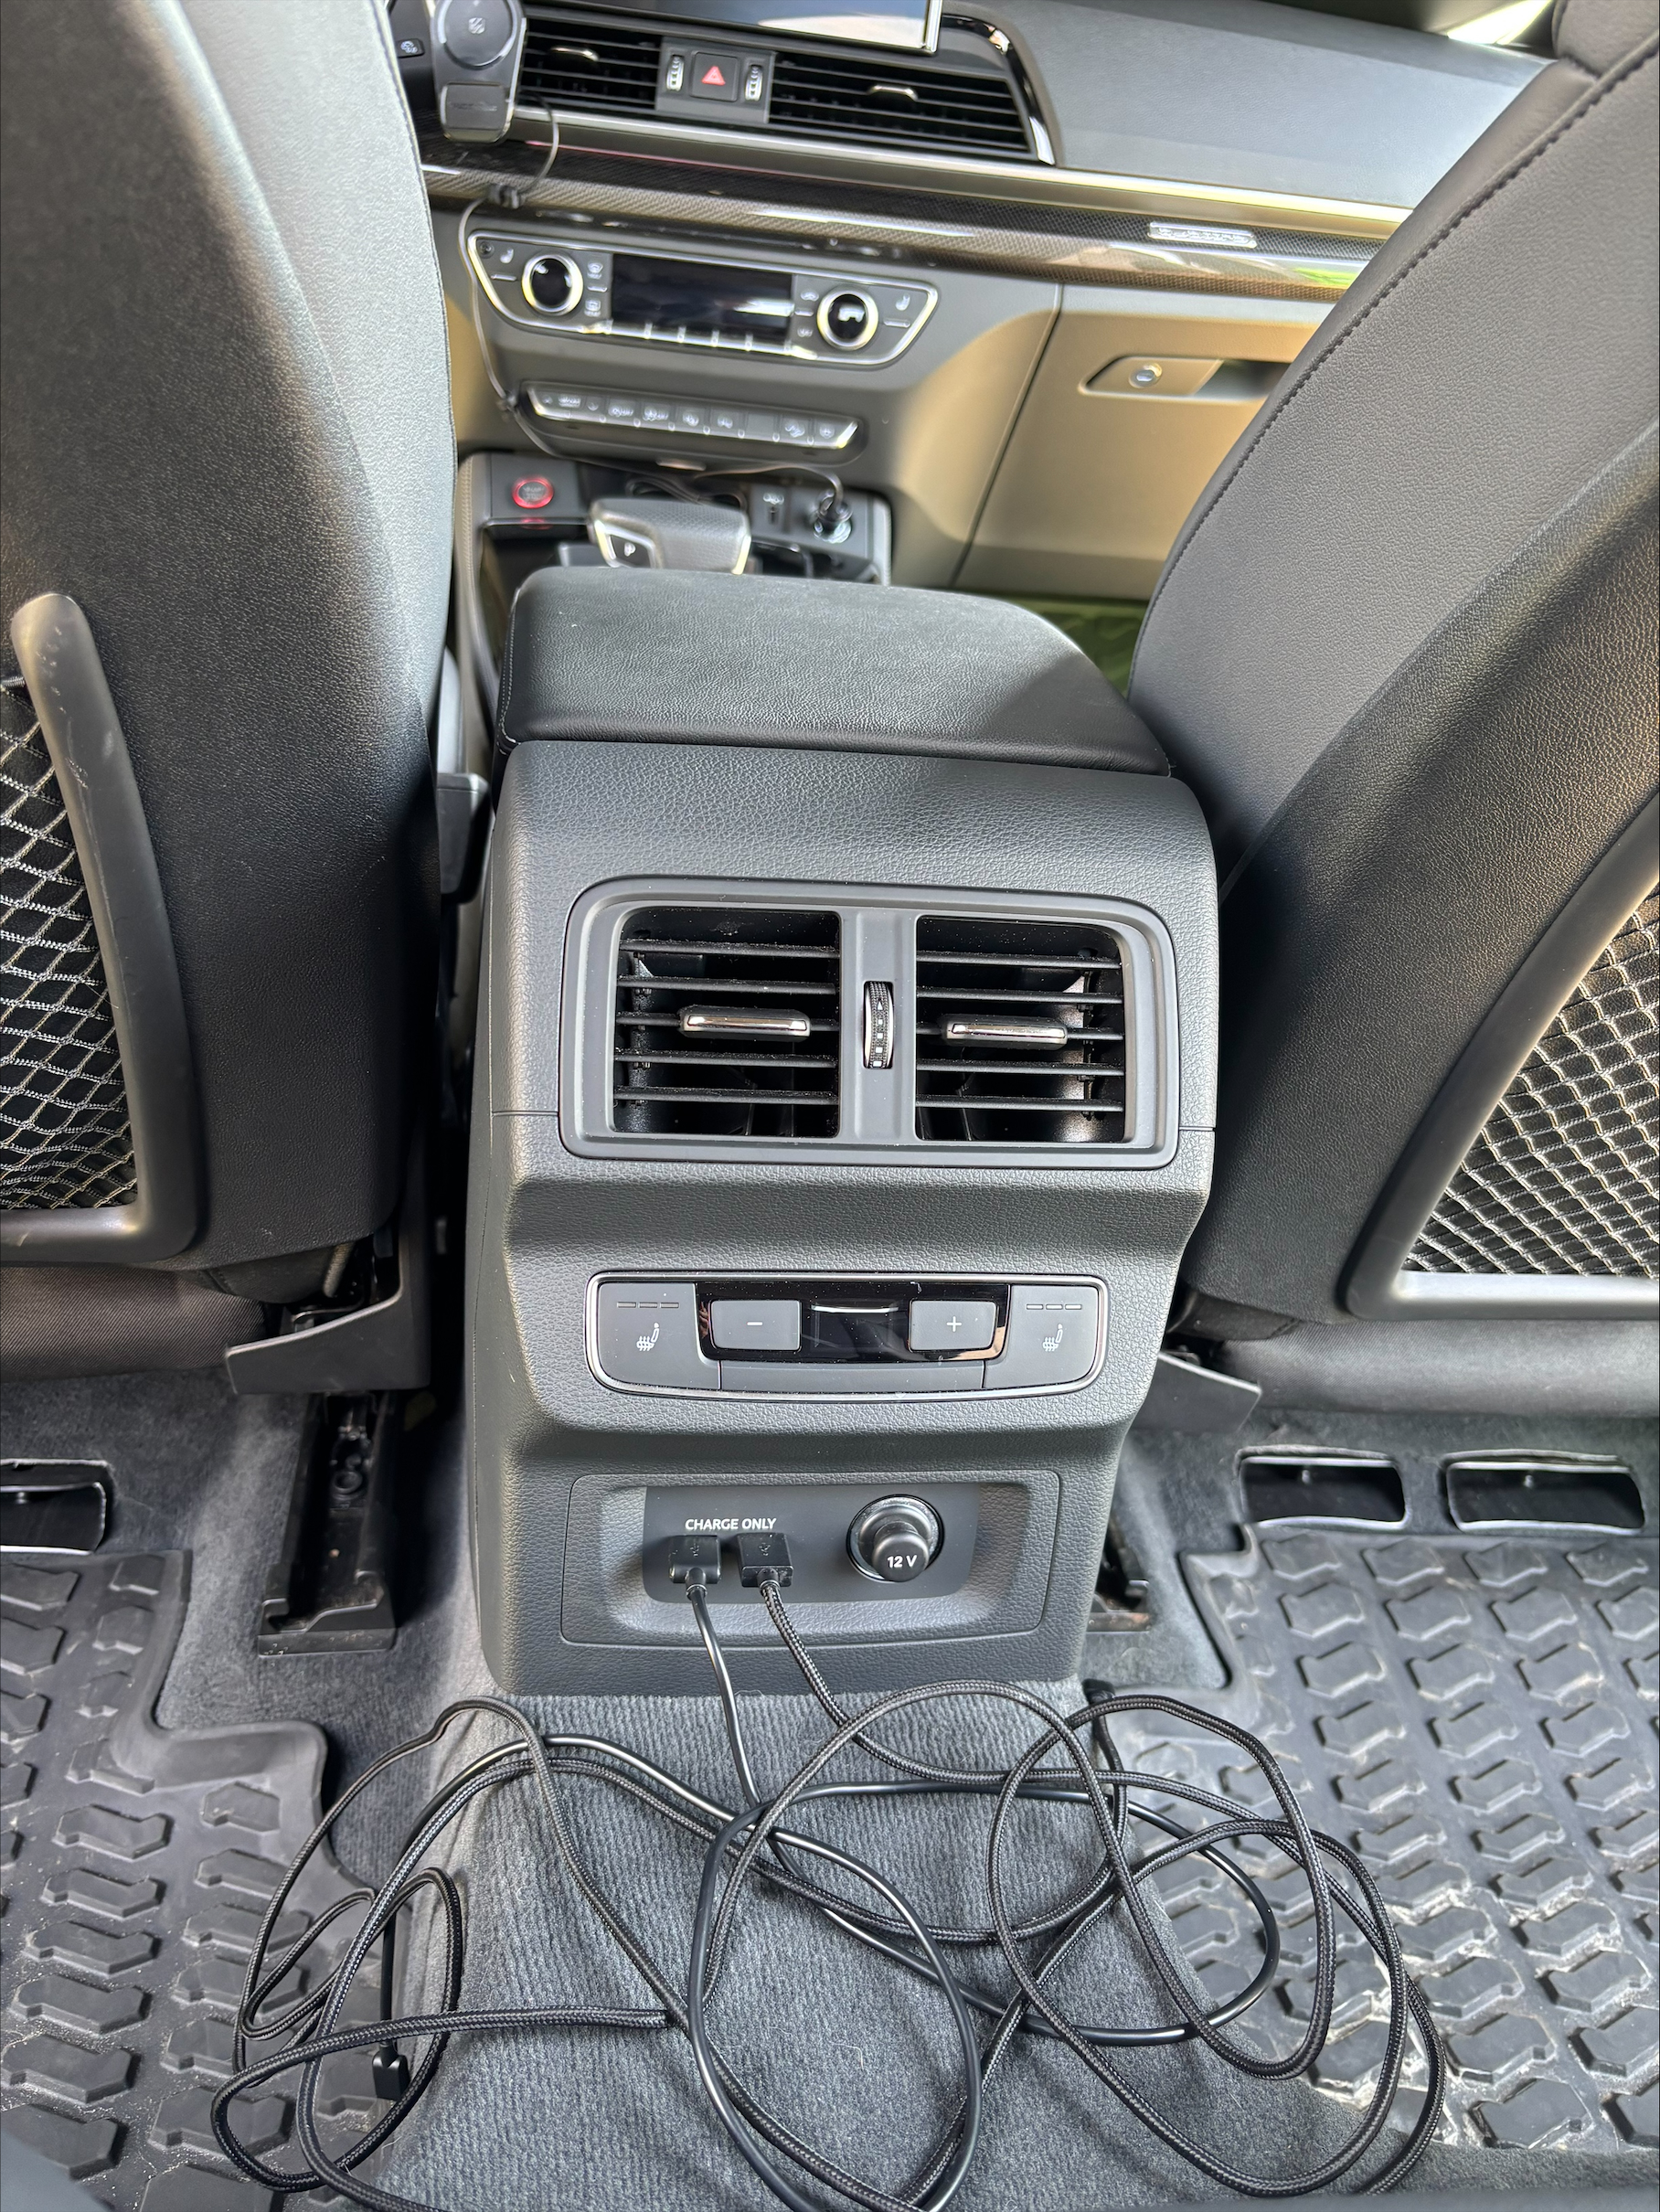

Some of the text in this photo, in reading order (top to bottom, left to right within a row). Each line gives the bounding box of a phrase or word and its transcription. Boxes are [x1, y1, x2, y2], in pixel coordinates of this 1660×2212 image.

[684, 1517, 777, 1531] CHARGE ONLY
[887, 1554, 918, 1569] 12 V
